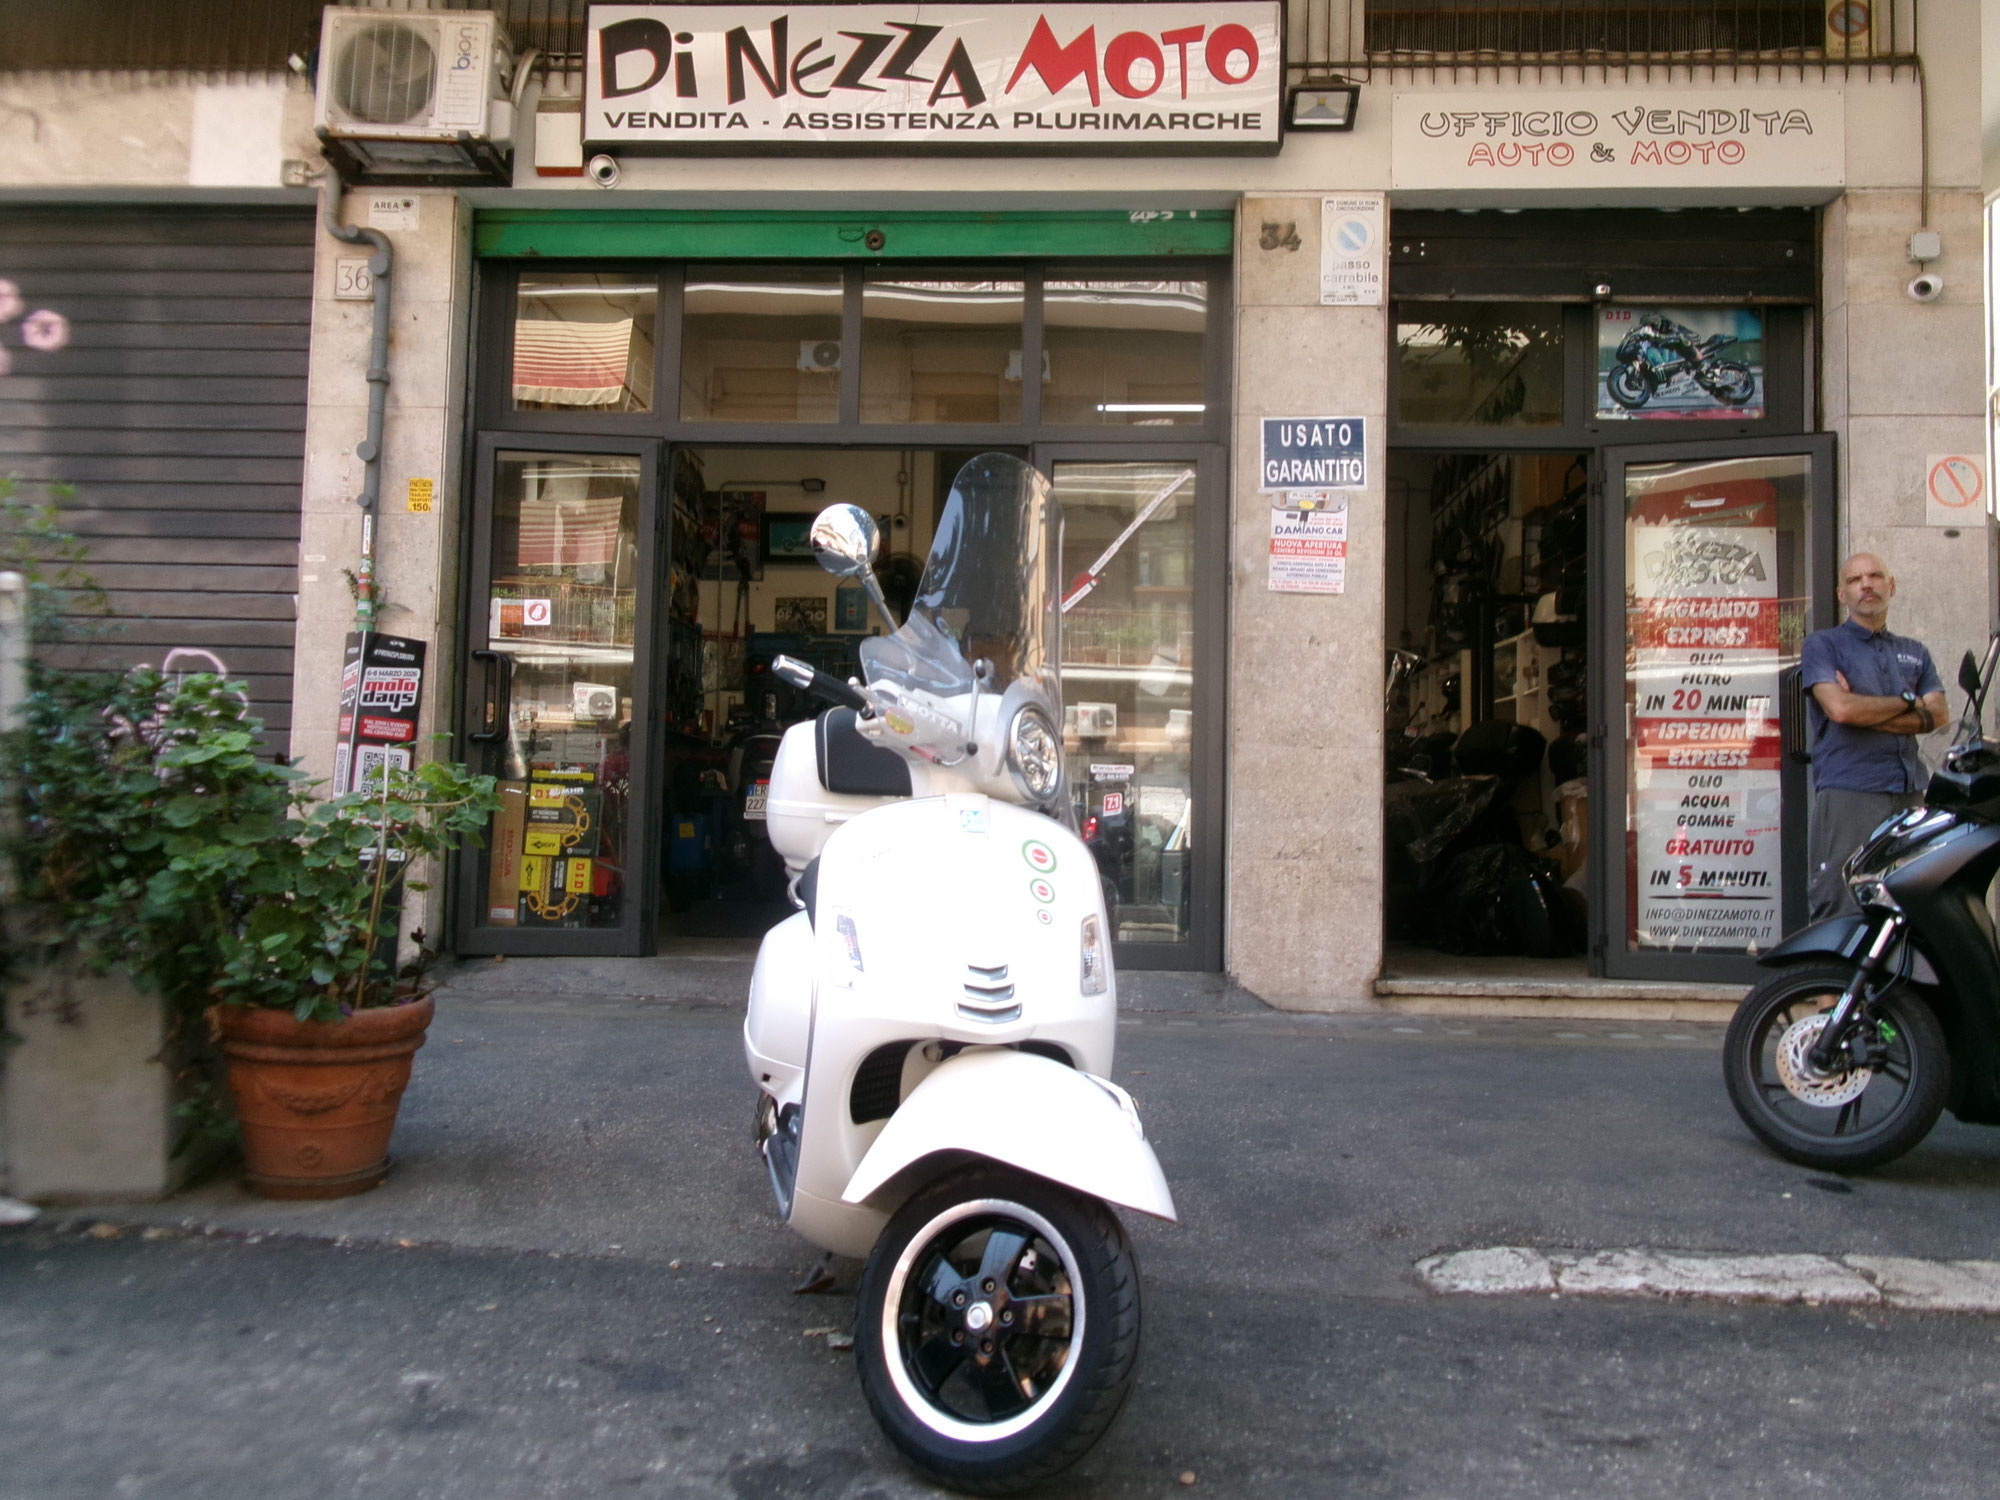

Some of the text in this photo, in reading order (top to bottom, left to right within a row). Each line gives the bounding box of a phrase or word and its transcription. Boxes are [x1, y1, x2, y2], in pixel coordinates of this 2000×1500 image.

[1004, 14, 1259, 108] MOTO
[604, 112, 749, 130] VENDITA
[783, 112, 999, 130] ASSISTENZA
[1013, 112, 1262, 130] PLURIMARCHE
[1420, 107, 1813, 138] UFFICIO VENDITA
[1467, 140, 1746, 167] AUTO & MOTO
[374, 201, 399, 209] AREA
[1259, 220, 1302, 251] 34
[1332, 261, 1370, 272] passo
[340, 265, 369, 290] 36
[1323, 272, 1379, 283] carrabile
[1280, 423, 1352, 447] USATO
[1266, 459, 1363, 482] GARANTITO
[1274, 525, 1343, 535] DAMIANO CAR
[1274, 539, 1343, 550] NUOVA APERTURA
[1654, 600, 1760, 619] TAGLIANDO
[1666, 626, 1749, 645] EXPRESS
[1689, 653, 1724, 665] OLIO
[379, 669, 401, 677] MARZO
[1681, 673, 1732, 686] FILTRO
[362, 691, 415, 708] days
[1645, 695, 1665, 710] IN
[1671, 689, 1702, 711] 20
[1658, 722, 1757, 740] ISPEZIONE
[1667, 749, 1750, 767] EXPRESS
[1688, 775, 1723, 788] OLIO
[755, 785, 767, 796] ER
[747, 798, 767, 810] 227
[1681, 795, 1730, 808] ACQUA
[1677, 814, 1735, 828] GOMME
[1665, 839, 1755, 856] GRATUITO
[1650, 870, 1671, 885] IN
[1677, 865, 1693, 887] 5
[1646, 909, 1775, 921] INFO@DINEZZAMOTO.IT
[1649, 926, 1772, 938] WWW.DINEZZAMOTO.IT
